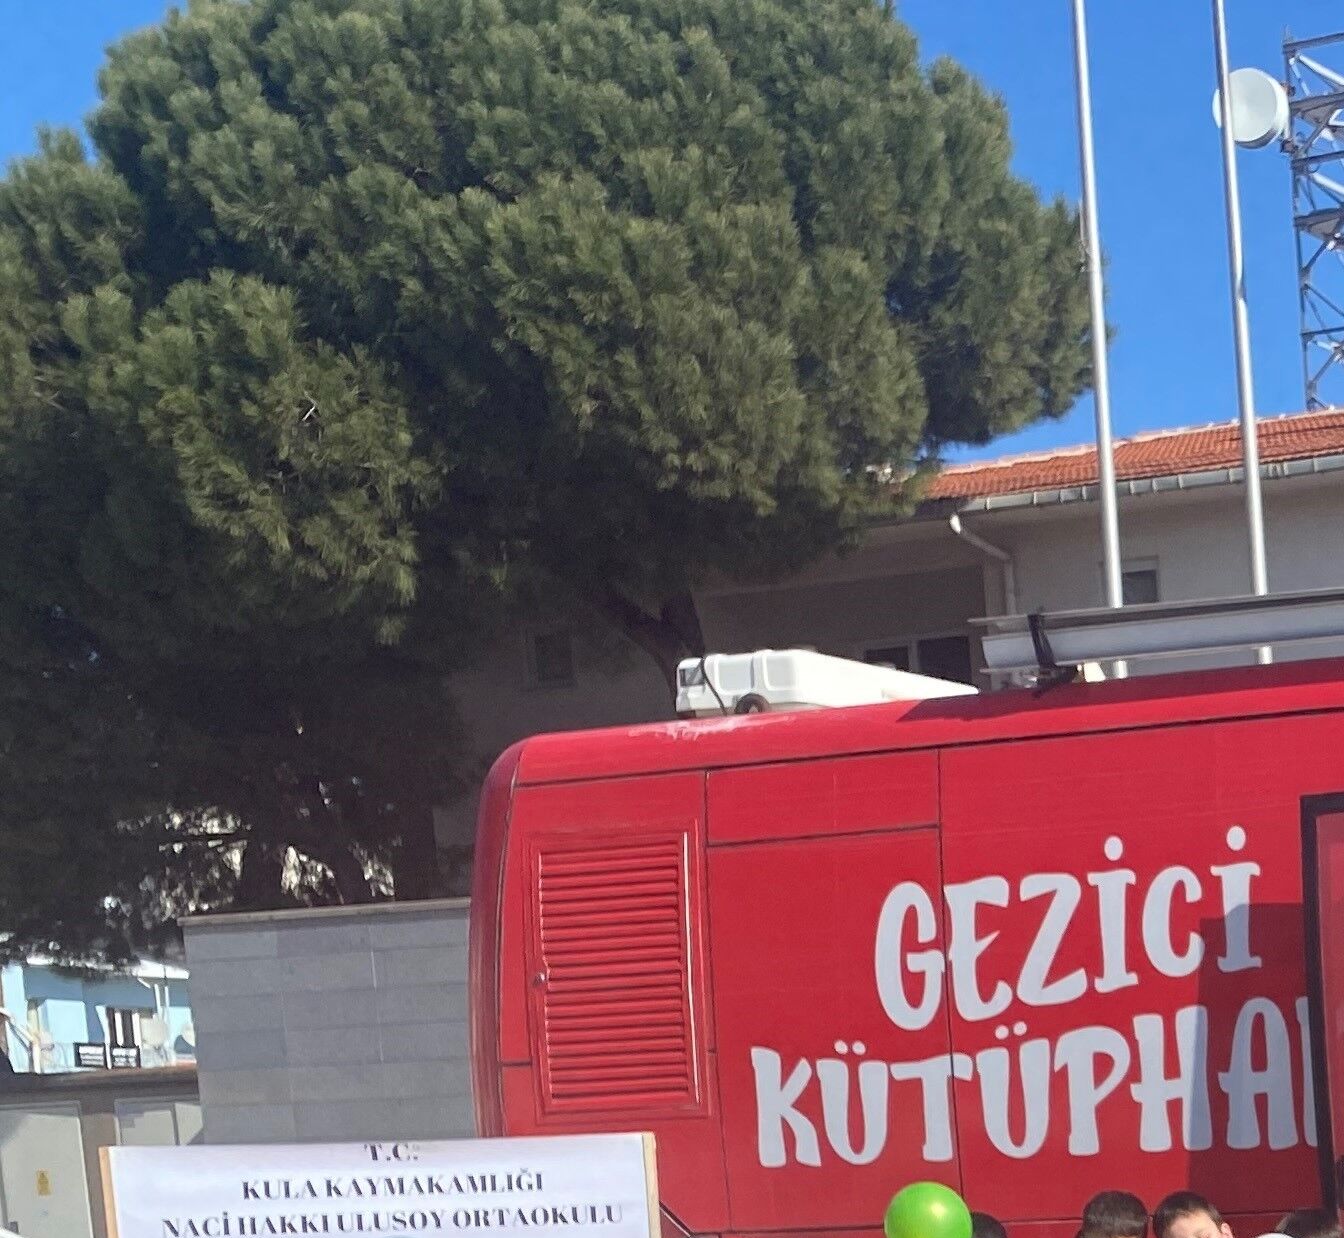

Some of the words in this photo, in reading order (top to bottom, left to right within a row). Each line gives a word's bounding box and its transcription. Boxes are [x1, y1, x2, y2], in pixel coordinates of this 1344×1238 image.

[874, 825, 1262, 1032] GEZİCİ
[241, 1179, 318, 1200] KULA
[325, 1168, 544, 1199] KAYMAKAMLIĞI
[162, 1211, 230, 1238] NACİ
[238, 1214, 330, 1236] HAKKI
[336, 1208, 444, 1233] ULUSOY
[452, 1204, 623, 1229] ORTAOKULU
